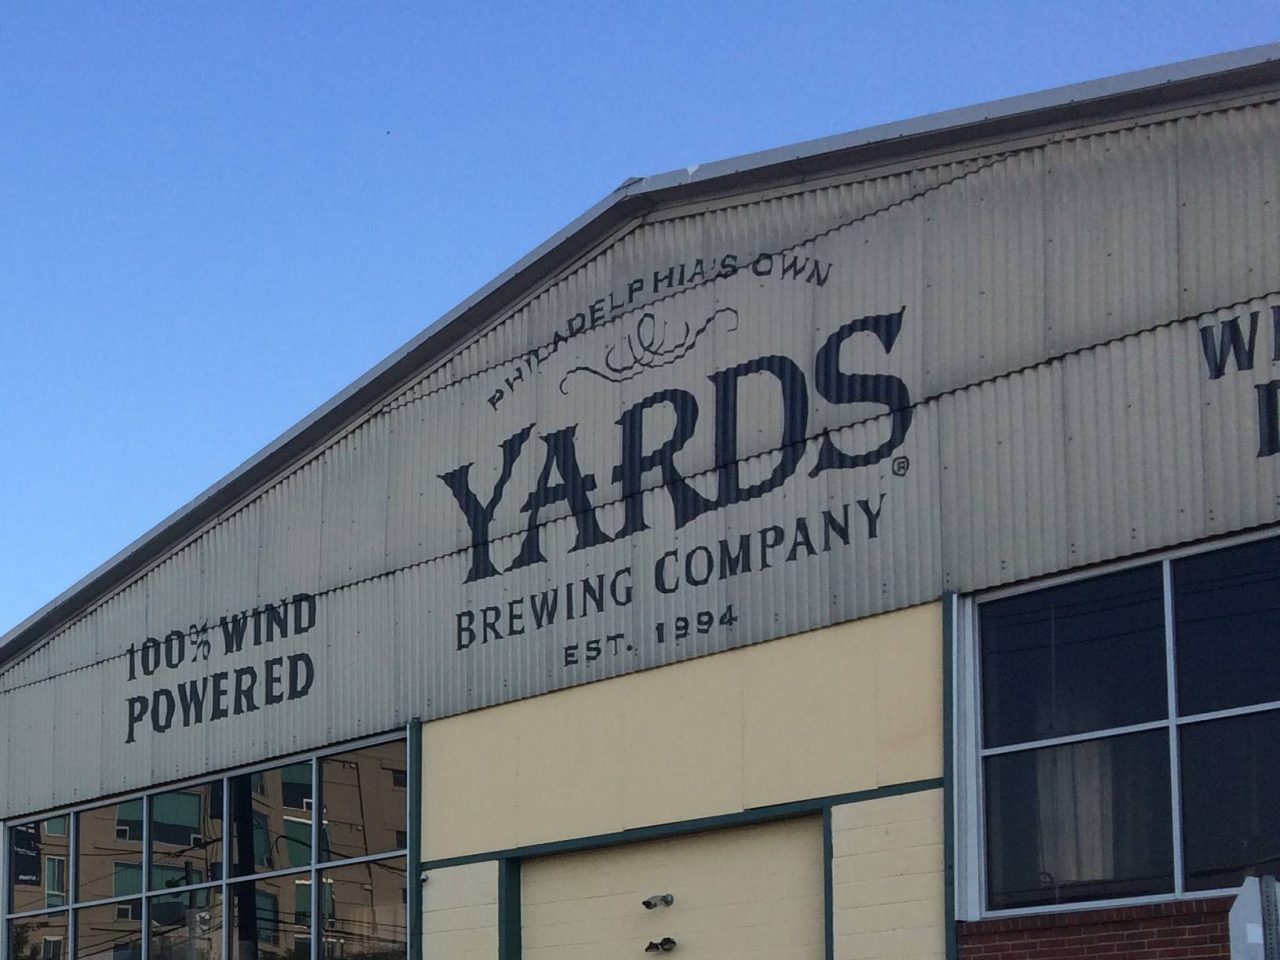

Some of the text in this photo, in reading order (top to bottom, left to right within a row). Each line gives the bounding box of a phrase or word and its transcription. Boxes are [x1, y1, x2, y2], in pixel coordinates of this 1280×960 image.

[487, 252, 833, 411] PHILADELPHIA'S OWN
[436, 305, 913, 585] YARDS
[455, 494, 886, 651] BREWING COMPANY
[125, 652, 314, 743] POWERED
[126, 592, 316, 681] 100% WIND
[563, 605, 738, 667] EST. 1994
